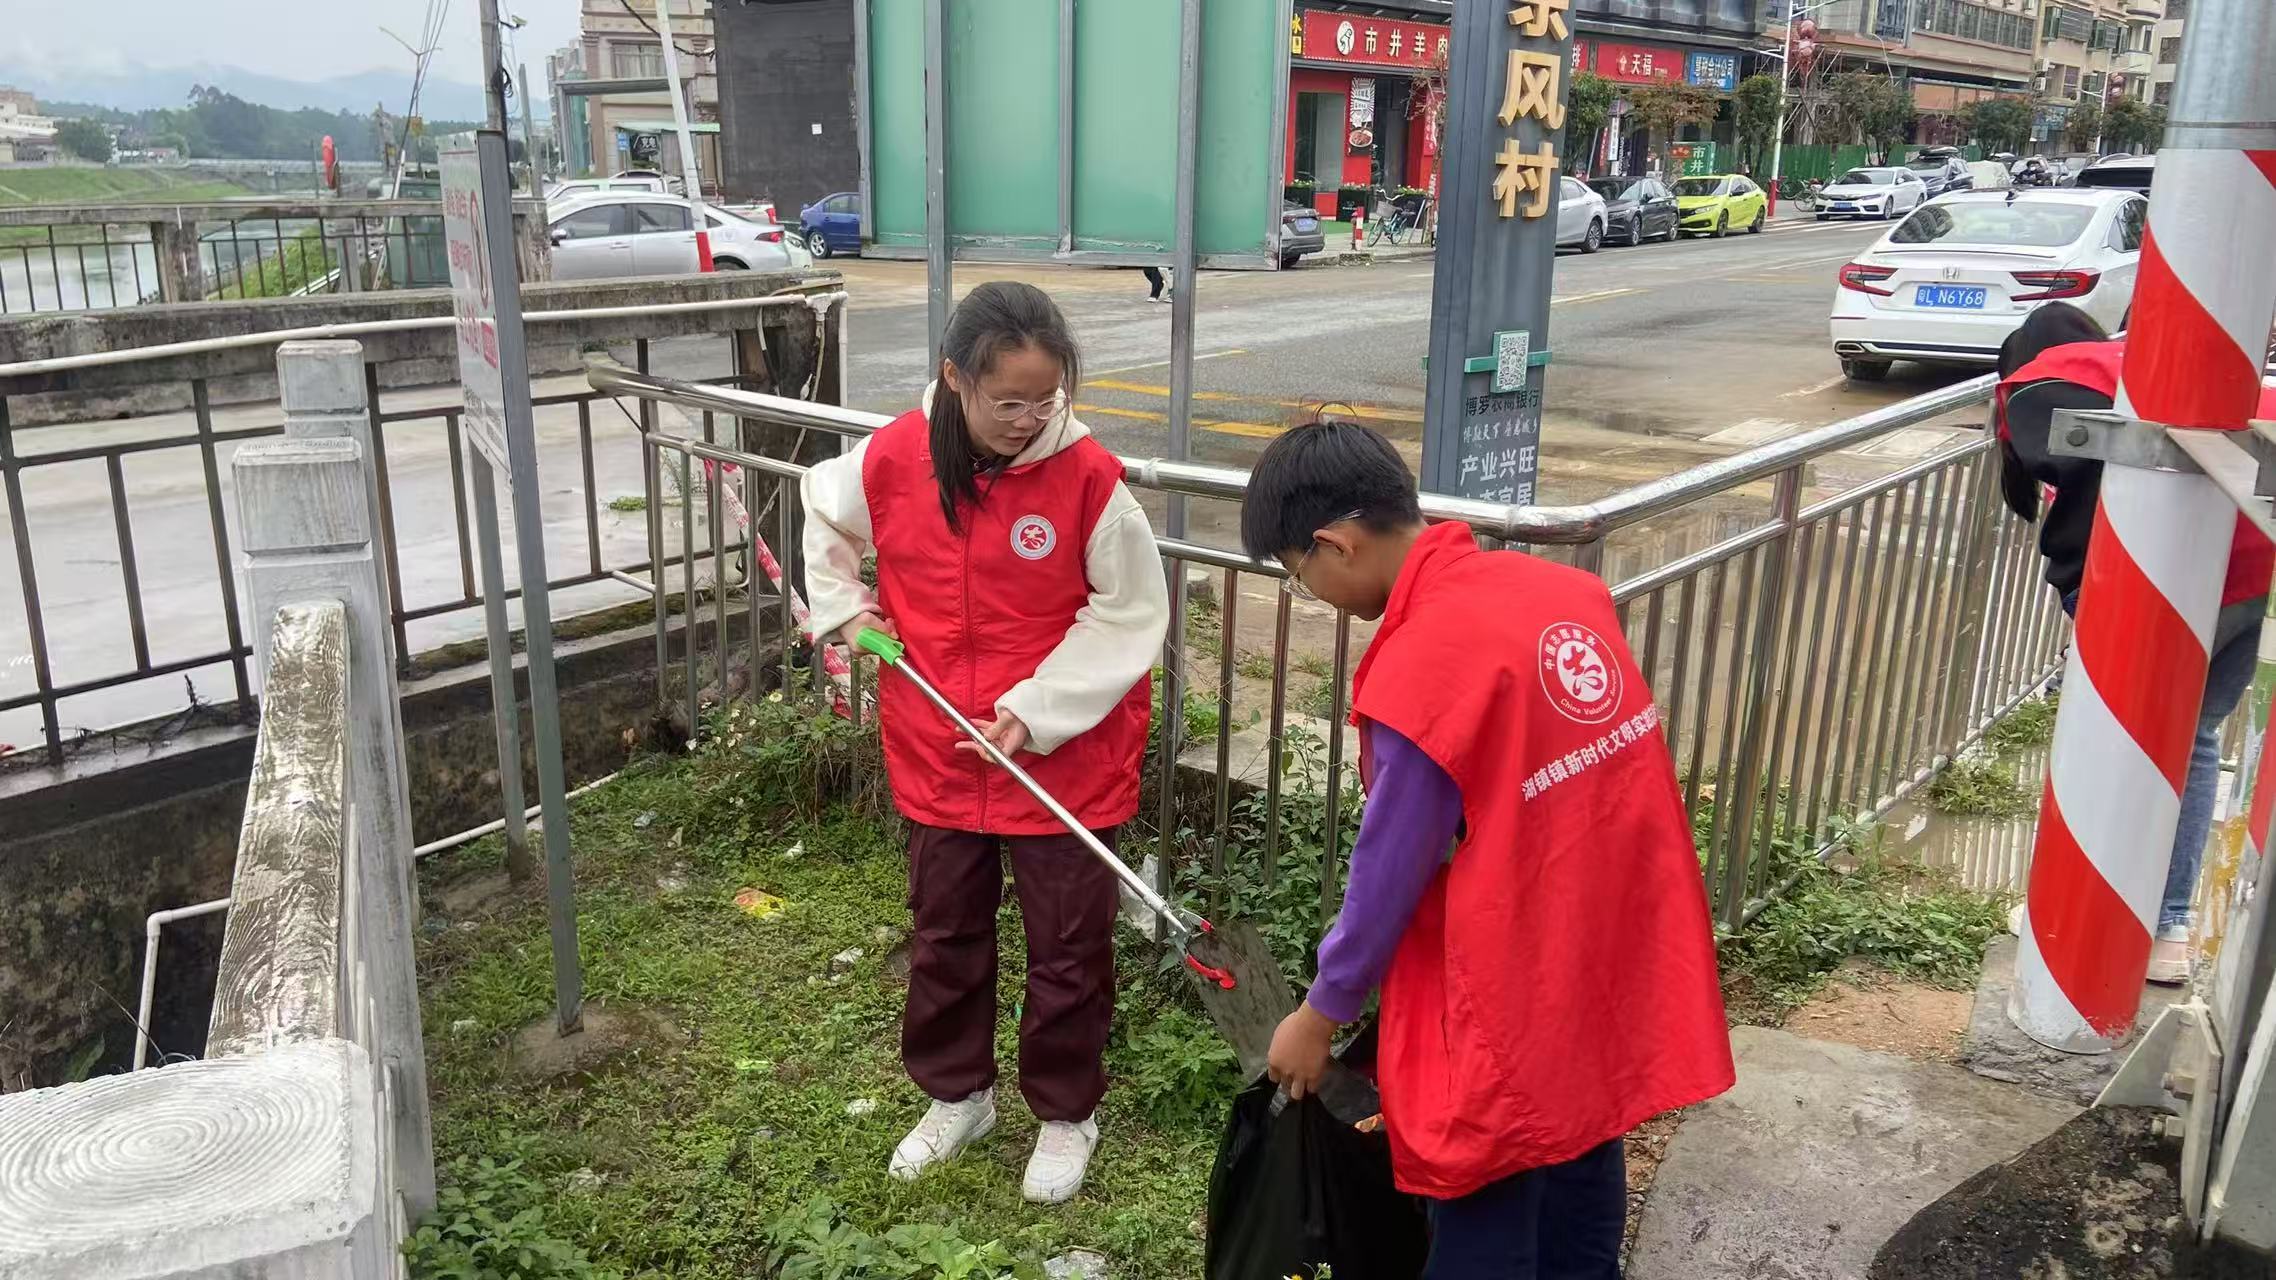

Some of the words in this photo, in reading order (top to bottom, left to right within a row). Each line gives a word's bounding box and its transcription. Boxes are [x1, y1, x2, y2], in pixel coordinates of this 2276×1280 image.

[1364, 26, 1448, 60] 市井羊肉
[1630, 53, 1654, 77] 天福
[1690, 145, 1706, 175] 市井
[1460, 446, 1535, 486] 产业兴旺
[1560, 697, 1582, 715] China
